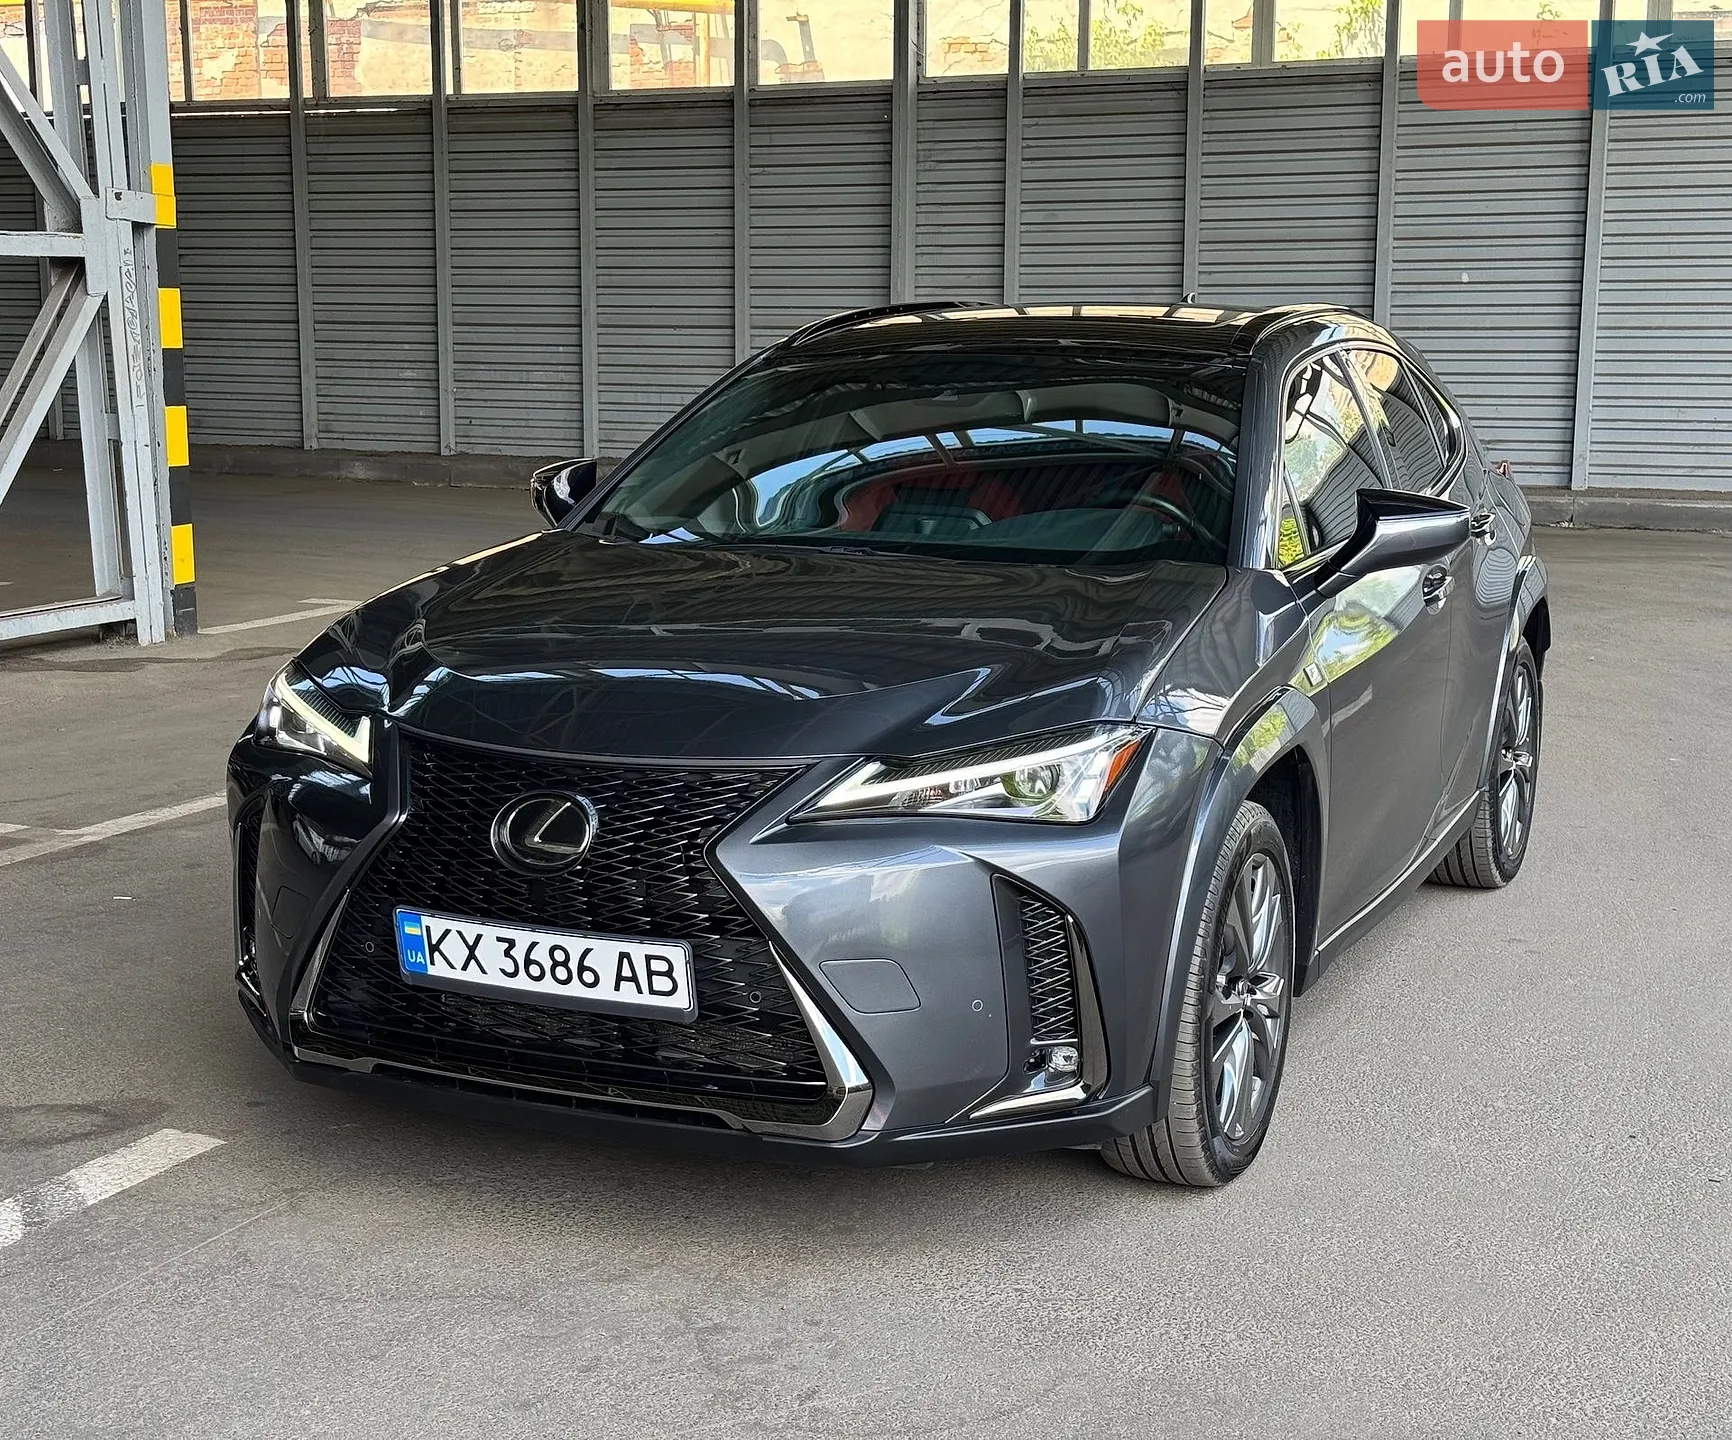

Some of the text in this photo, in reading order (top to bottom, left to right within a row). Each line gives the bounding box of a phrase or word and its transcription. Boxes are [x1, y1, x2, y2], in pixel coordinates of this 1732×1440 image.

[407, 949, 425, 965] UA
[425, 925, 679, 997] KX 3686 AB
